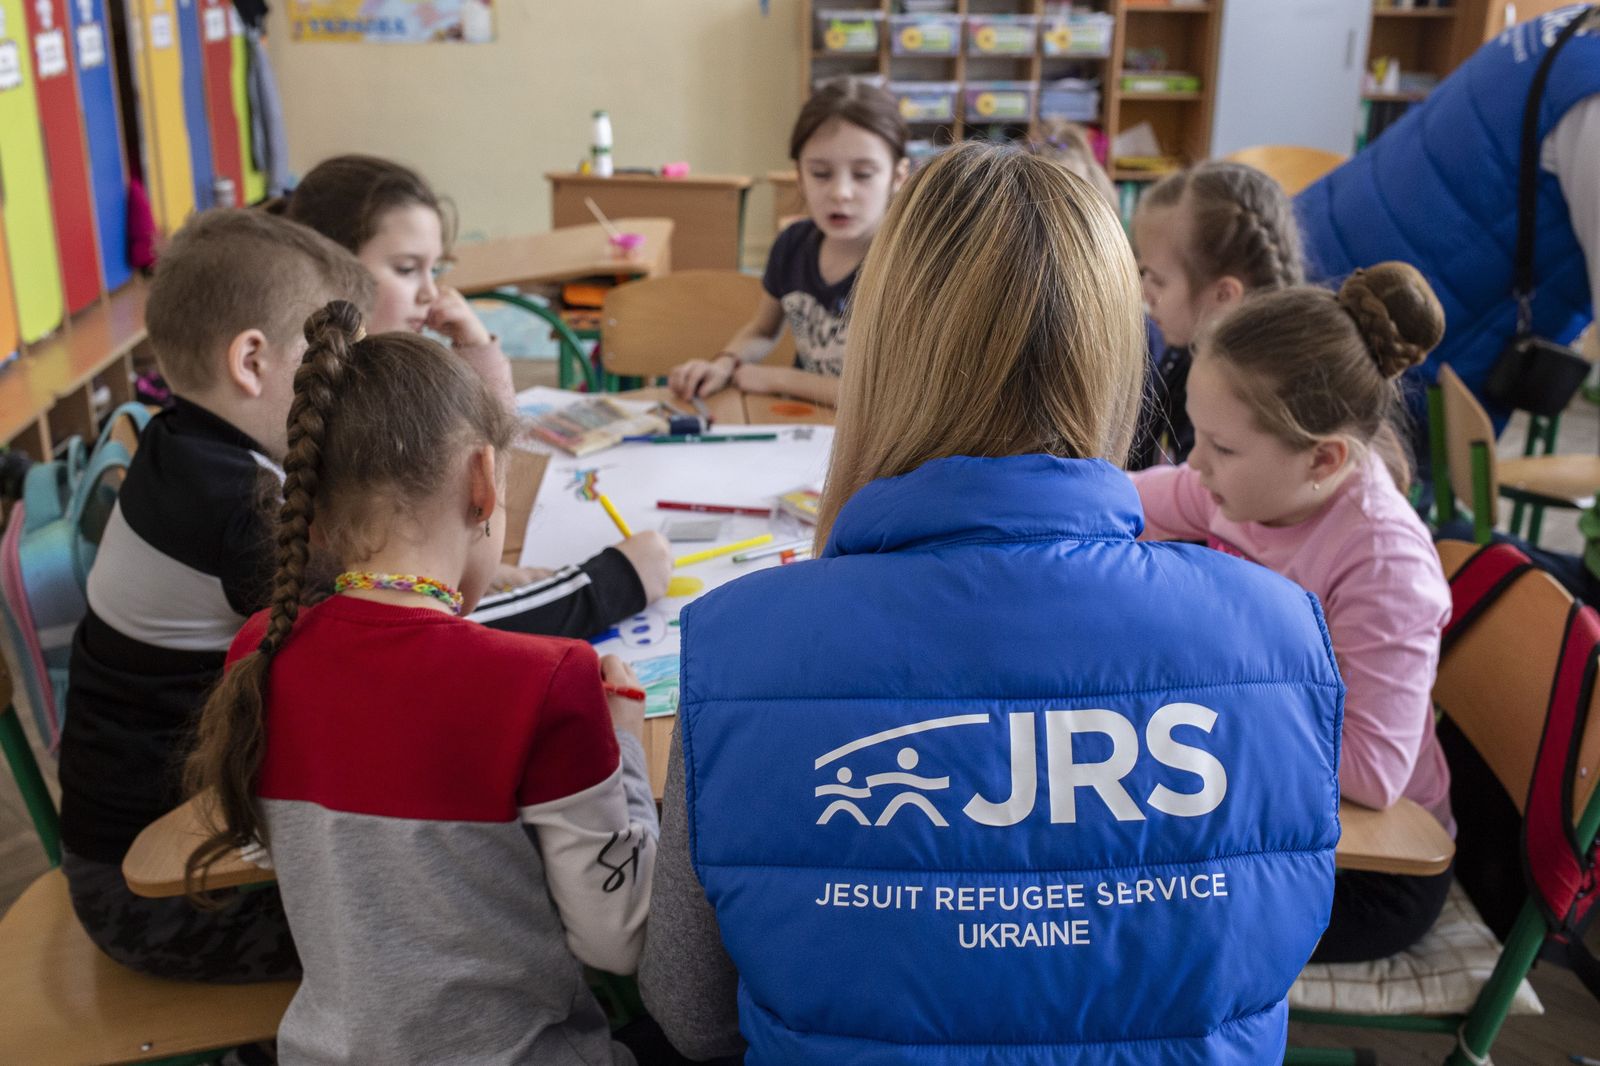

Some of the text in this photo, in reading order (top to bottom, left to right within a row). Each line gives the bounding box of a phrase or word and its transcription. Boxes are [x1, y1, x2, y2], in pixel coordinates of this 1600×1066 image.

[962, 702, 1227, 827] JRS
[815, 873, 1229, 911] JESUIT REFUGEE SERVICE
[958, 919, 1091, 949] UKRAINE
